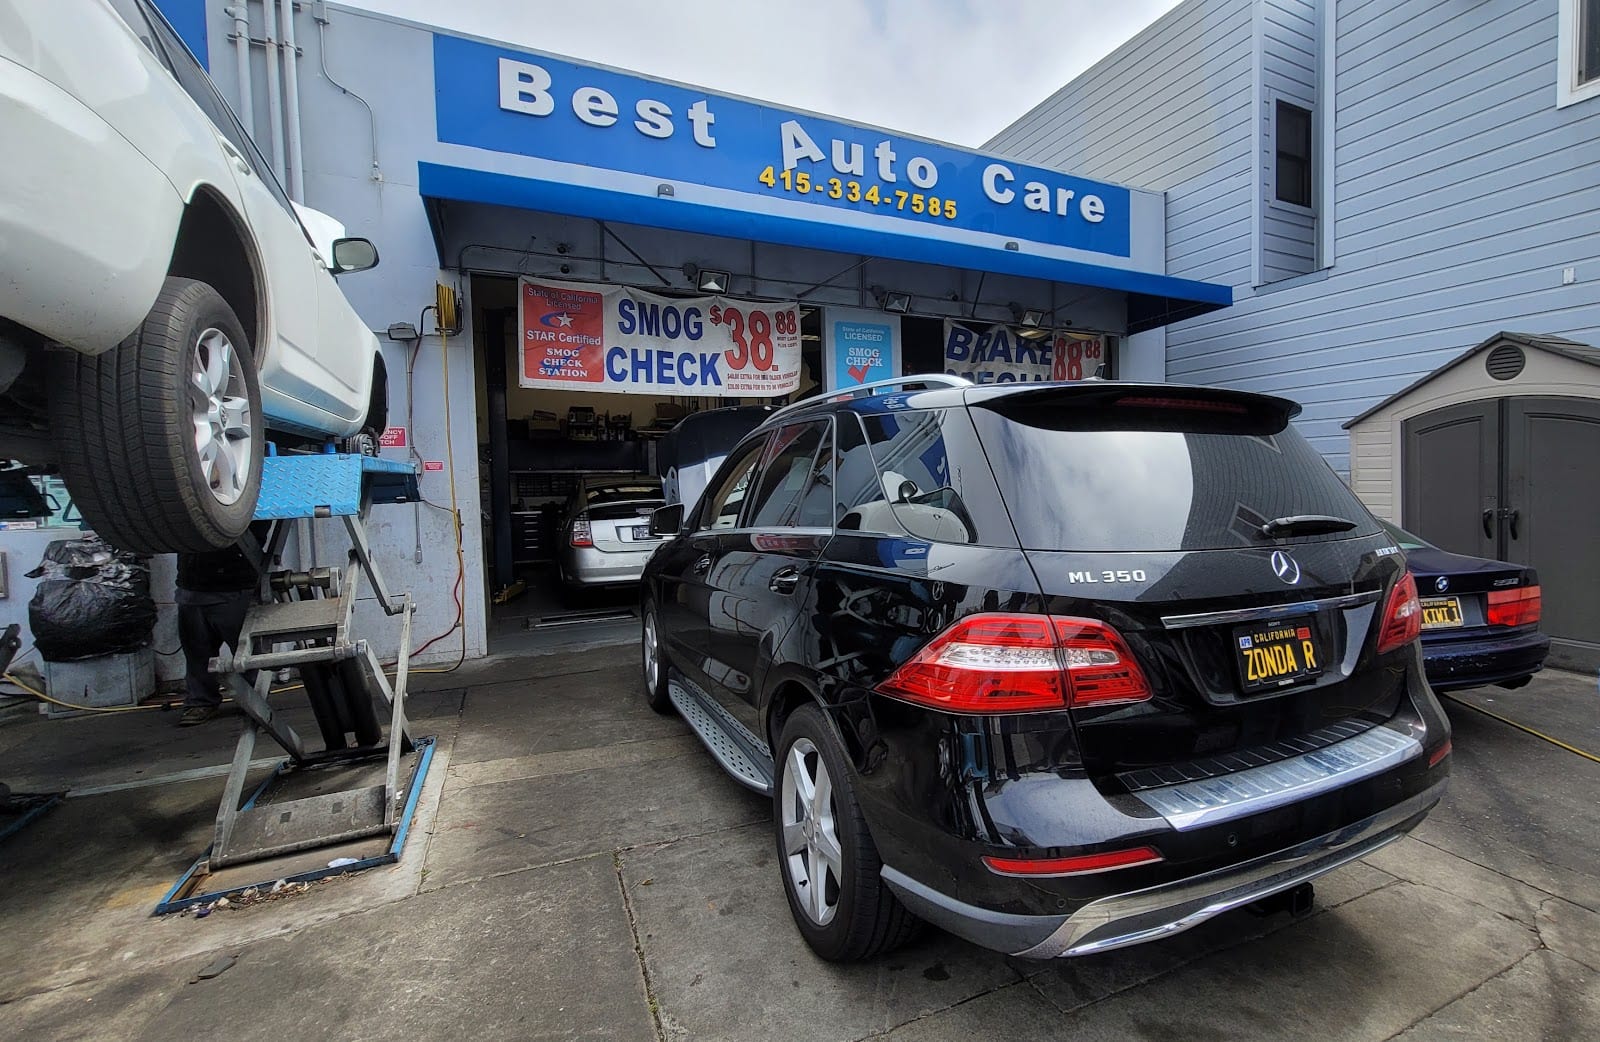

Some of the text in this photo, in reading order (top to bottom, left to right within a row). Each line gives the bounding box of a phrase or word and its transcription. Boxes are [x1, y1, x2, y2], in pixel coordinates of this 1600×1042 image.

[498, 57, 1106, 224] Best Auto Care
[759, 166, 959, 220] 415-334-7585
[528, 288, 598, 304] State of California
[546, 299, 582, 310] Licensed
[618, 298, 704, 341] SMOG
[527, 330, 601, 345] STAR Certified
[844, 332, 883, 341] LICENSED
[546, 348, 580, 357] SMOG
[848, 347, 880, 357] SMOG
[946, 326, 1052, 365] BRAKE
[543, 357, 583, 368] CHECK
[606, 346, 722, 386] CHECK
[846, 356, 883, 367] CHECK
[539, 367, 588, 377] STATION
[1068, 569, 1146, 584] ML 350
[1254, 628, 1296, 643] CALIFORNIA
[1243, 640, 1317, 680] ZONDA R
